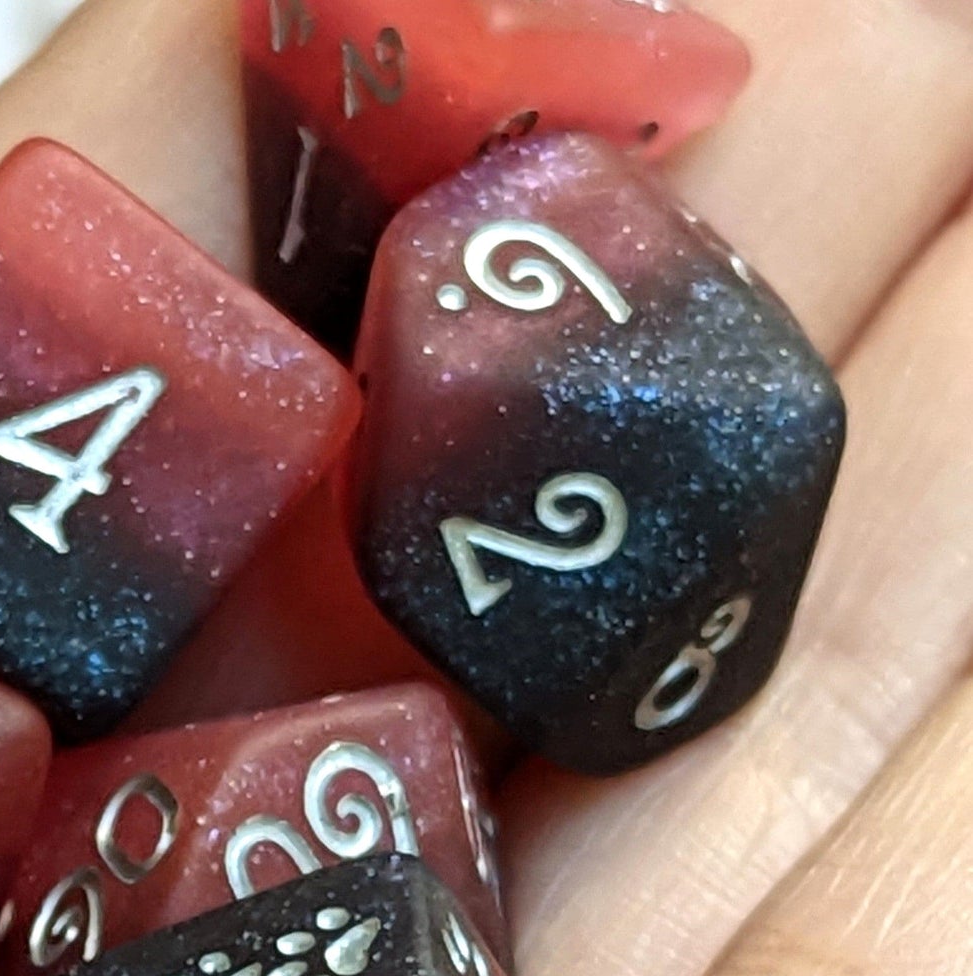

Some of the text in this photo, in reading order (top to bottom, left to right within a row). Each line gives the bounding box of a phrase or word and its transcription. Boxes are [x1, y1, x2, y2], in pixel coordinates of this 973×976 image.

[340, 26, 406, 119] 2
[439, 473, 627, 616] 2
[634, 598, 751, 731] 8
